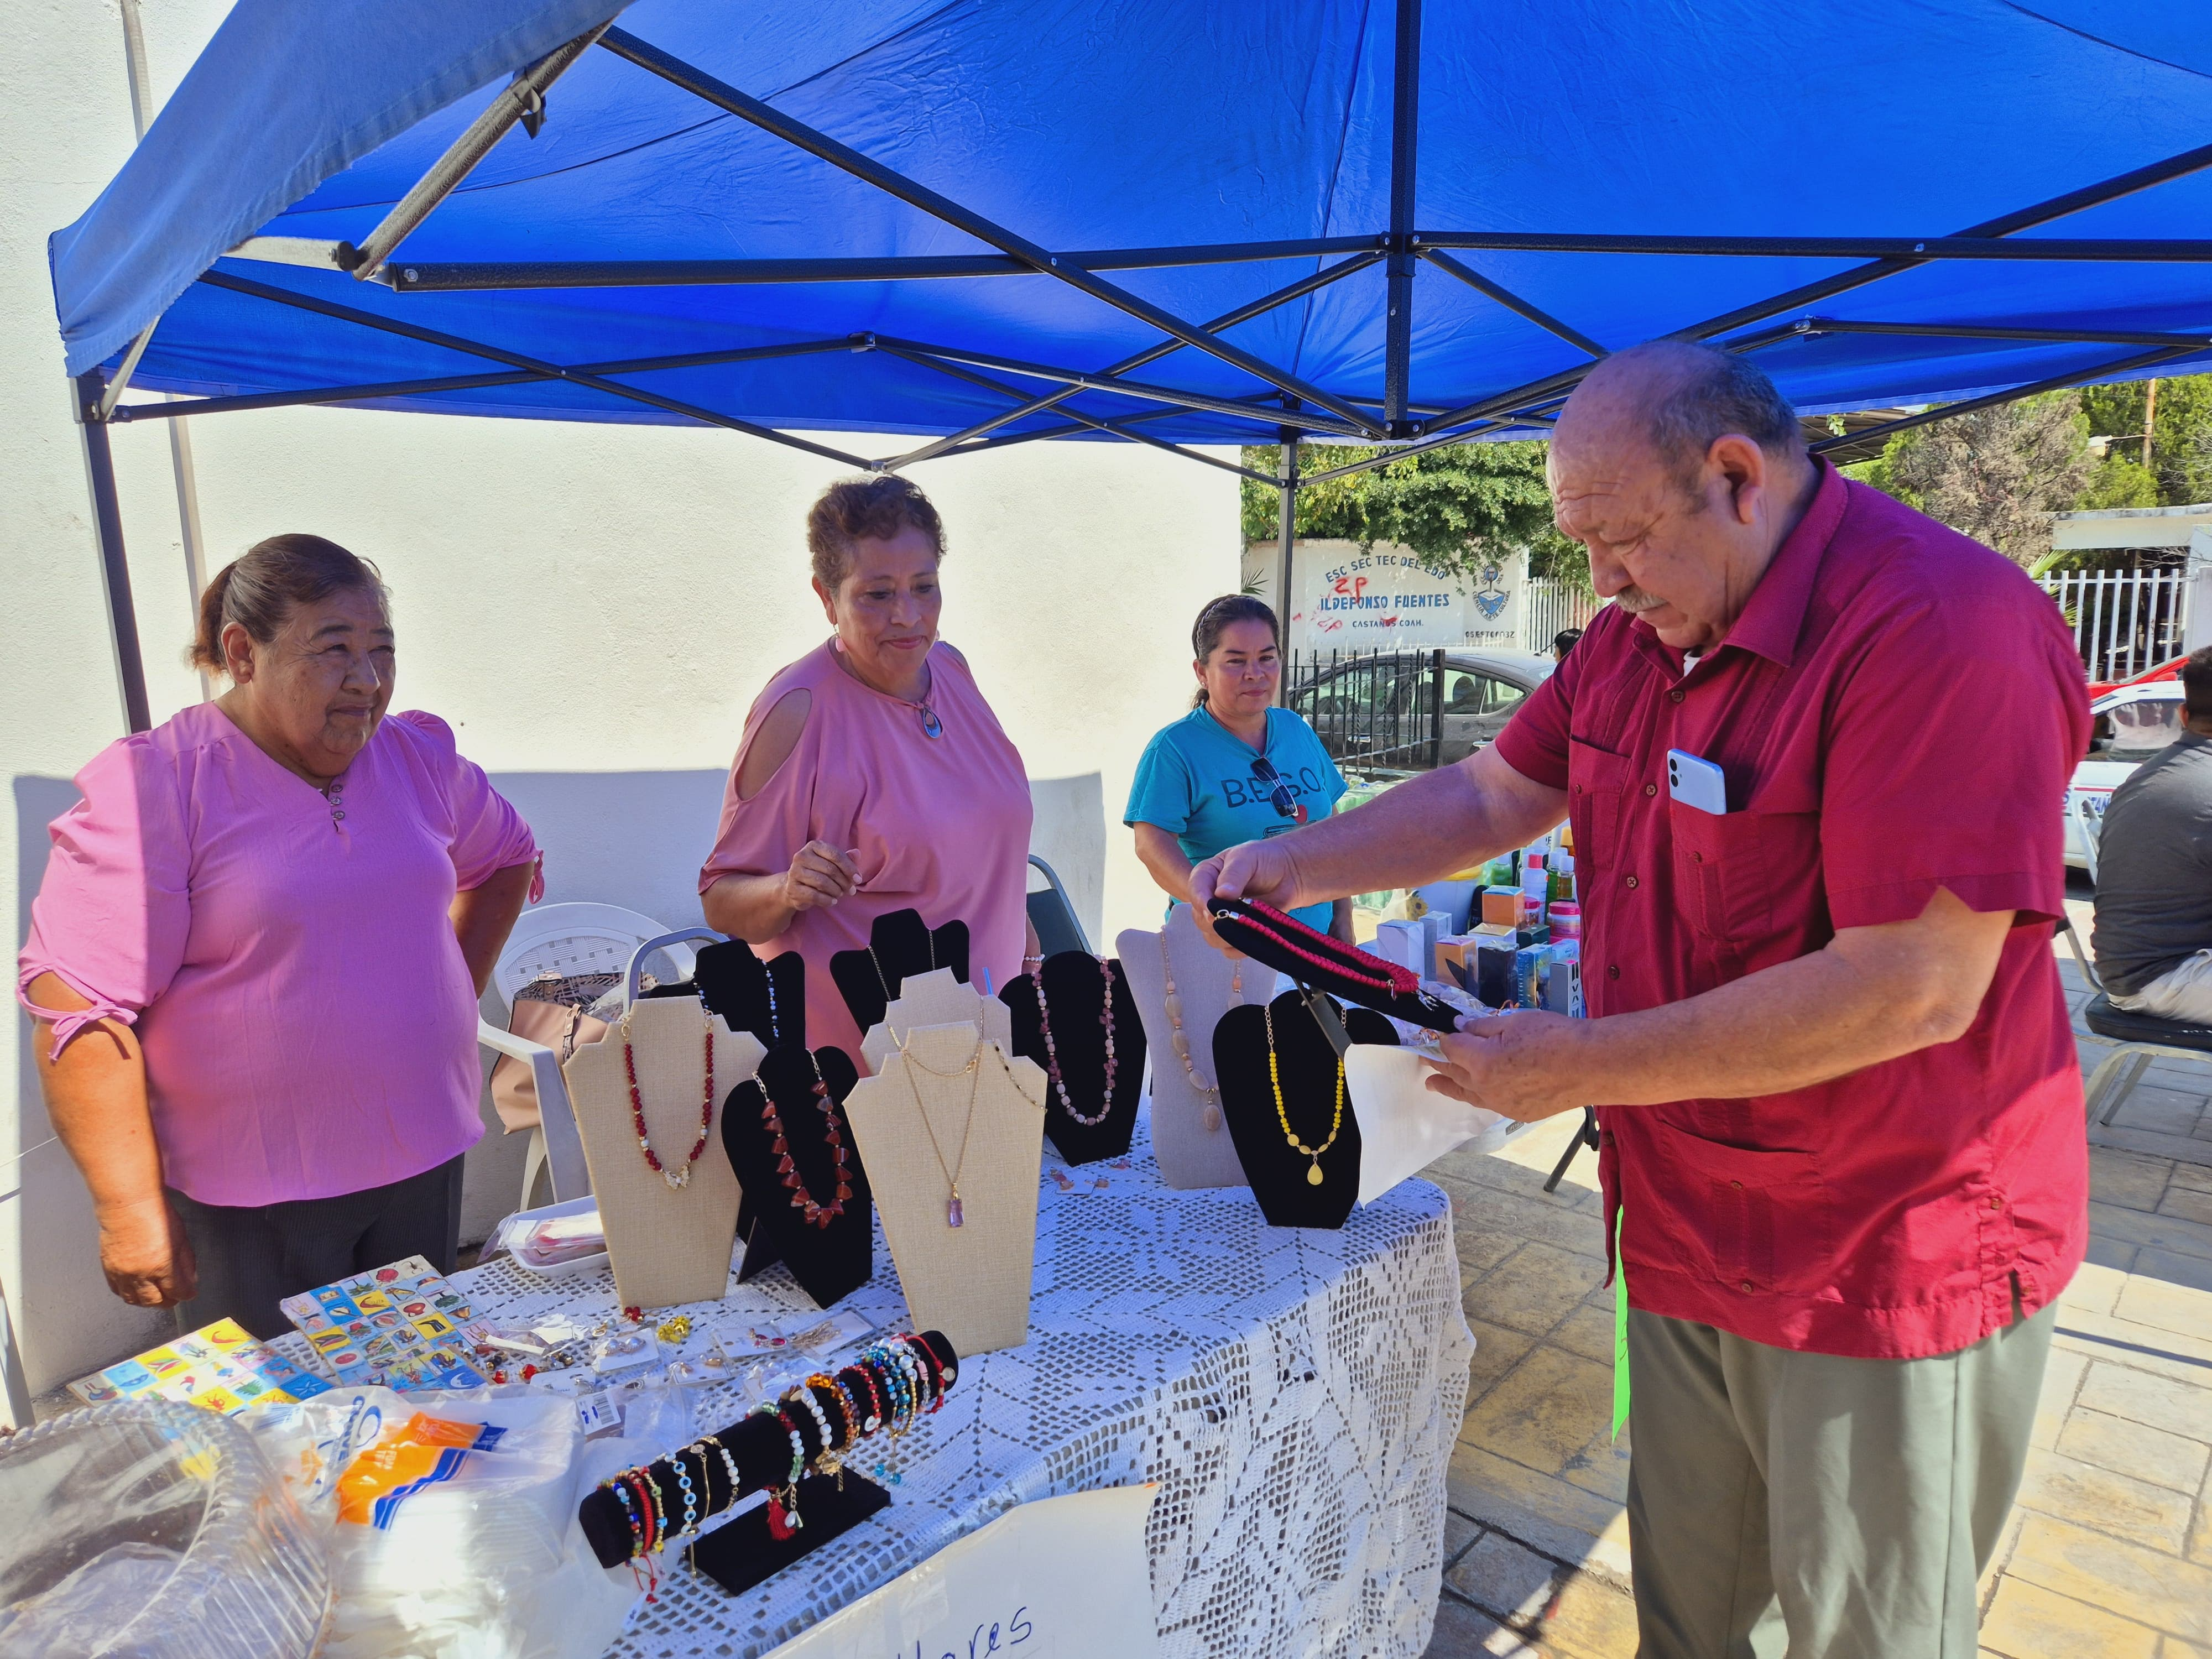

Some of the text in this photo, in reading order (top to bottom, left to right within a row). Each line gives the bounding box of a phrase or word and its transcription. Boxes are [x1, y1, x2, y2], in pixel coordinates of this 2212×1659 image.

[1325, 566, 1347, 583] ESC
[1350, 557, 1372, 571] SEC
[1375, 555, 1396, 565] TEC
[1400, 556, 1421, 570] DEL
[1320, 593, 1449, 611] ILDEFONSO FUENTES
[1484, 611, 1499, 619] ARTE
